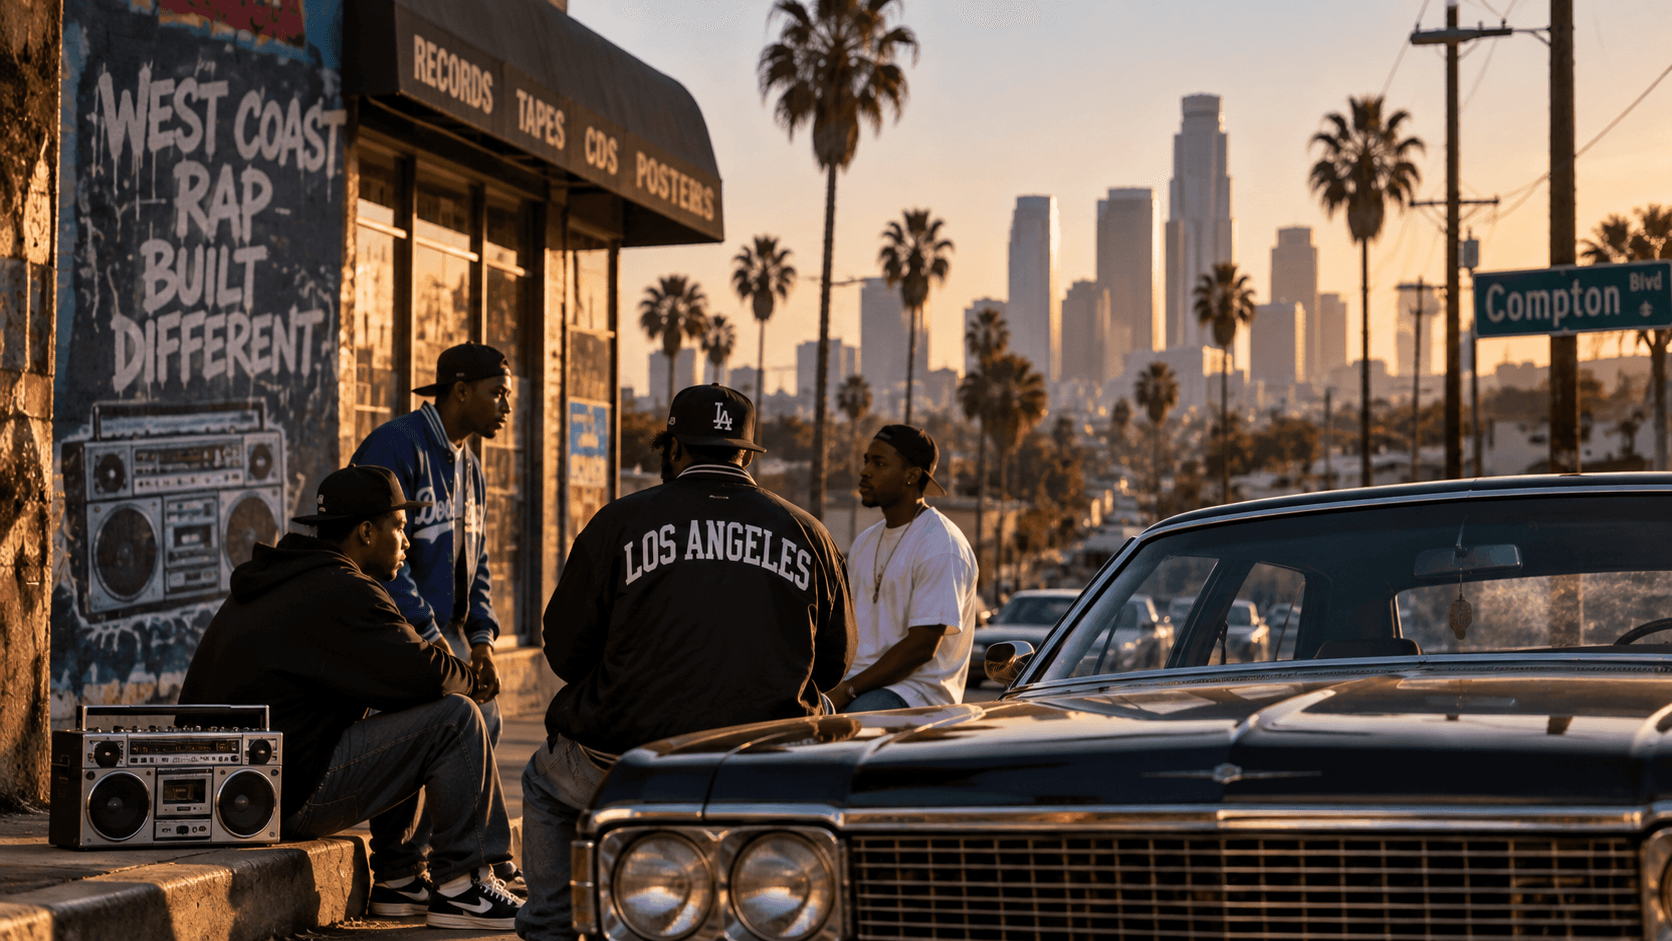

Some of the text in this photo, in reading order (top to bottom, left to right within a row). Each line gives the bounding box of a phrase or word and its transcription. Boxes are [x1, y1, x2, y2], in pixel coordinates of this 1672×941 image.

[98, 67, 347, 178] WEST COAST
[413, 34, 493, 115] RECORDS
[516, 88, 565, 150] TAPES
[585, 126, 618, 175] CDS
[173, 160, 273, 242] RAP
[140, 238, 268, 313] BUILT
[1485, 271, 1663, 328] Compton Blvd
[110, 309, 325, 392] DIFFERENT
[713, 402, 733, 431] LA
[624, 519, 812, 591] LOS ANGELES
